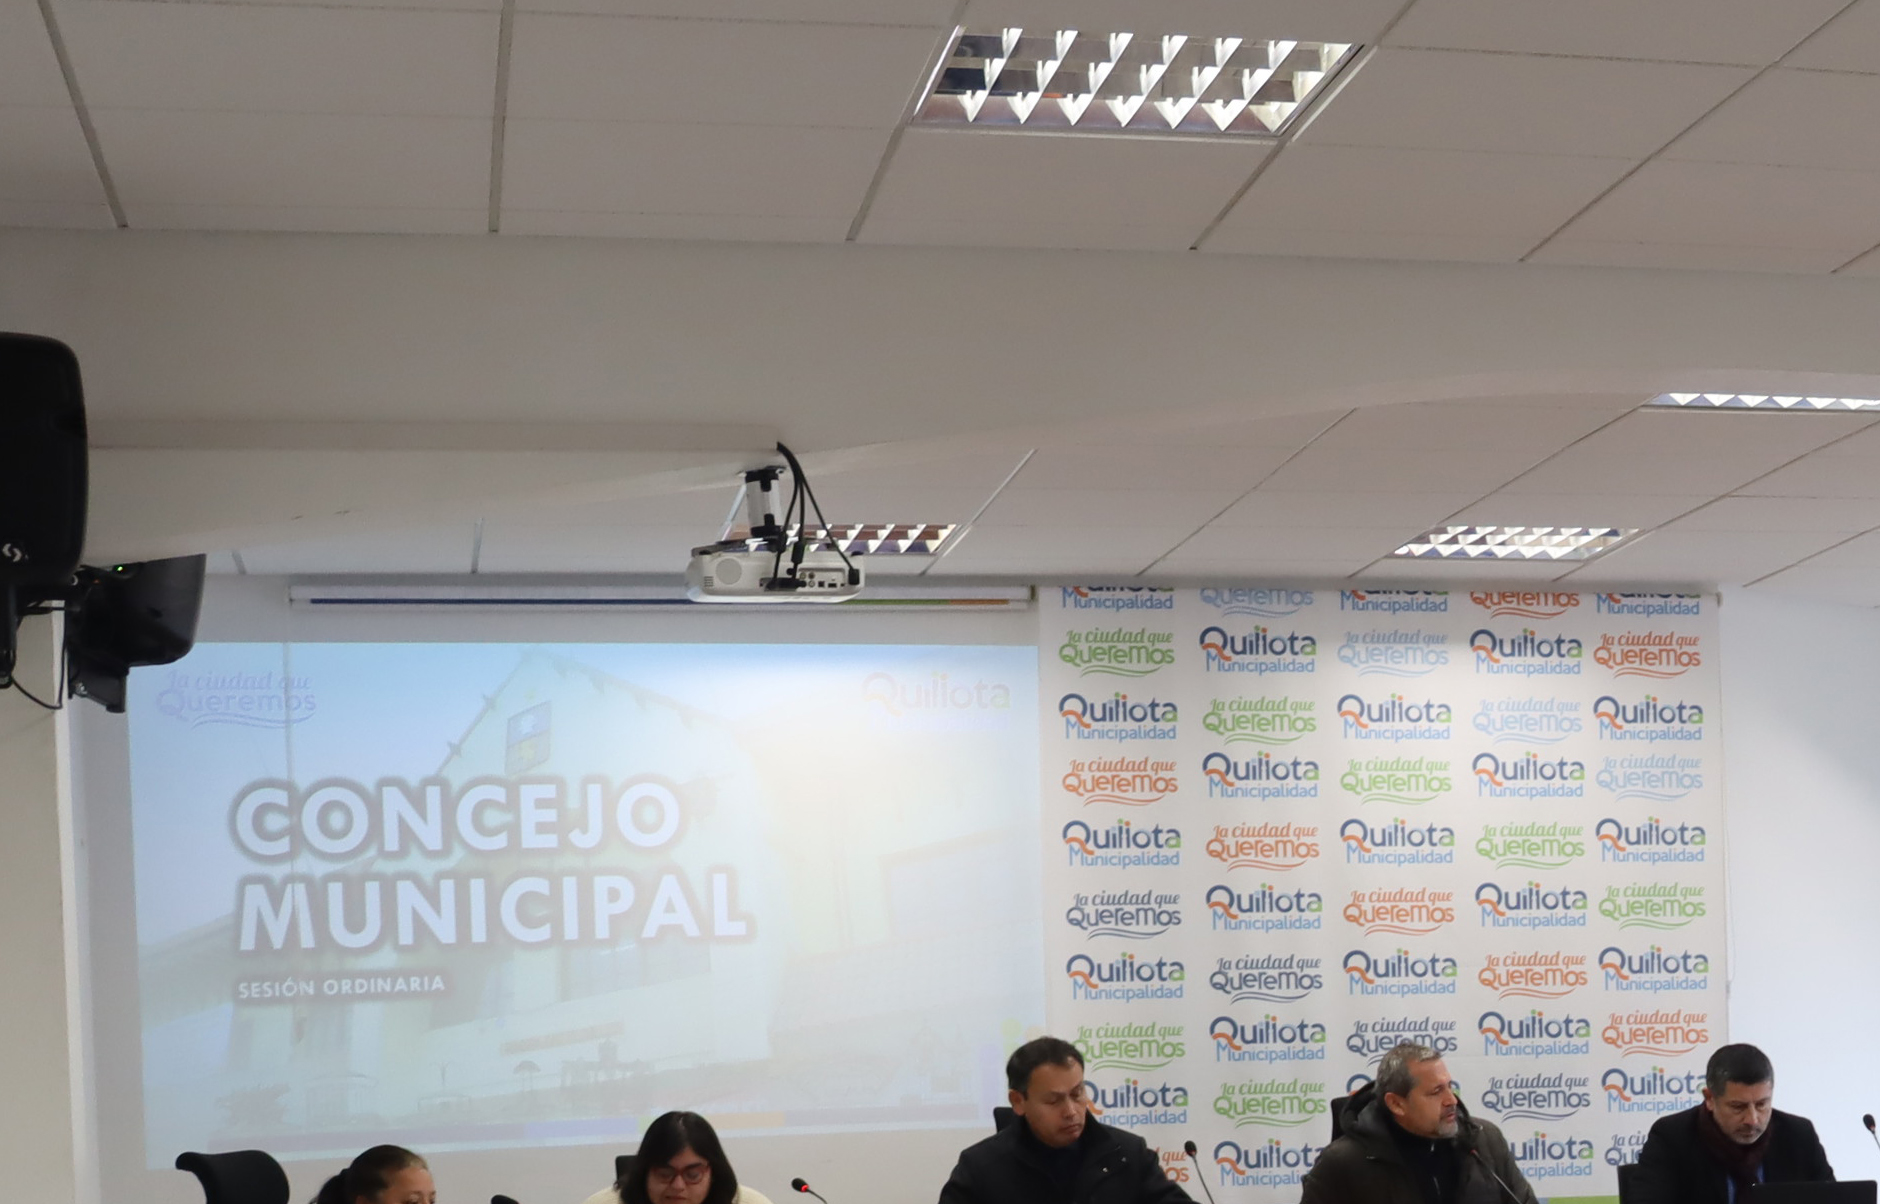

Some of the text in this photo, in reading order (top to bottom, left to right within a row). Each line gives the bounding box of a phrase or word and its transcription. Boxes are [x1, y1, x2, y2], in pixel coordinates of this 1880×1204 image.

[1062, 587, 1173, 611] Municipalidad
[1340, 591, 1448, 614] Municipalidad
[1597, 594, 1700, 617] Municipalidad
[1085, 627, 1145, 643] ciudad
[1148, 630, 1173, 645] que
[1200, 626, 1316, 661] Quillota
[1362, 629, 1420, 644] ciudad
[1423, 631, 1447, 646] que
[1470, 629, 1582, 663] Quillota
[1618, 631, 1673, 646] ciudad
[1676, 634, 1699, 649] que
[1060, 644, 1174, 666] Queremos
[1206, 650, 1315, 675] Municipalidad
[1476, 652, 1580, 676] Municipalidad
[1594, 647, 1700, 668] Queremos
[1059, 693, 1178, 728] Quillota
[1228, 696, 1287, 711] ciudad
[1291, 698, 1315, 714] que
[1338, 693, 1451, 728] Quillota
[1497, 697, 1554, 712] ciudad
[1557, 699, 1581, 714] que
[1594, 695, 1703, 729] Quillota
[1066, 717, 1176, 742] Municipalidad
[1202, 712, 1316, 734] Queremos
[1344, 717, 1449, 742] Municipalidad
[1600, 718, 1702, 742] Municipalidad
[1089, 756, 1149, 772] ciudad
[1152, 759, 1177, 774] que
[1202, 751, 1319, 786] Quillota
[1365, 756, 1423, 771] ciudad
[1426, 758, 1450, 773] que
[1473, 752, 1585, 787] Quillota
[1620, 754, 1675, 769] ciudad
[1678, 756, 1702, 771] que
[1062, 772, 1178, 795] Queremos
[1209, 775, 1317, 800] Municipalidad
[1340, 772, 1451, 794] Queremos
[1479, 775, 1583, 800] Municipalidad
[235, 782, 681, 856] CONCEJO
[1232, 822, 1290, 838] ciudad
[1293, 825, 1318, 840] que
[1500, 821, 1557, 836] ciudad
[1560, 823, 1583, 839] que
[1062, 819, 1181, 854] Quillota
[1340, 818, 1454, 852] Quillota
[1596, 816, 1706, 851] Quillota
[1069, 843, 1179, 868] Municipalidad
[1206, 838, 1319, 861] Queremos
[1346, 841, 1452, 865] Municipalidad
[1476, 837, 1584, 859] Queremos
[1602, 840, 1704, 864] Municipalidad
[1092, 890, 1152, 906] ciudad
[1155, 893, 1180, 909] que
[1206, 883, 1322, 918] Quillota
[1368, 888, 1426, 903] ciudad
[1429, 890, 1453, 906] que
[1475, 881, 1587, 916] Quillota
[1623, 882, 1678, 897] ciudad
[1681, 884, 1705, 899] que
[238, 872, 749, 951] MUNICIPAL
[1066, 907, 1181, 930] Queremos
[1212, 907, 1320, 932] Municipalidad
[1343, 904, 1454, 926] Queremos
[1481, 905, 1586, 929] Municipalidad
[1599, 898, 1706, 920] Queremos
[1067, 953, 1185, 988] Quillota
[1235, 954, 1293, 970] ciudad
[1296, 957, 1321, 973] que
[1343, 949, 1457, 984] Quillota
[1503, 951, 1560, 966] ciudad
[1562, 954, 1586, 969] que
[1599, 945, 1708, 979] Quillota
[238, 975, 445, 999] SESIÓN ORDINARIA
[1073, 977, 1183, 1002] Municipalidad
[1210, 971, 1322, 994] Queremos
[1349, 973, 1455, 997] Municipalidad
[1478, 967, 1587, 989] Queremos
[1605, 969, 1707, 993] Municipalidad
[1371, 1016, 1430, 1033] ciudad
[1431, 1021, 1457, 1035] que
[1478, 1010, 1590, 1044] Quillota
[1626, 1009, 1681, 1024] ciudad
[1684, 1012, 1707, 1027] que
[1096, 1022, 1156, 1038] ciudad
[1158, 1026, 1184, 1040] que
[1210, 1014, 1325, 1050] Quillota
[1602, 1025, 1708, 1047] Queremos
[1216, 1038, 1324, 1063] Municipalidad
[1485, 1033, 1588, 1057] Municipalidad
[1239, 1078, 1298, 1094] ciudad
[1301, 1081, 1325, 1096] que
[1506, 1074, 1562, 1089] ciudad
[1565, 1076, 1589, 1091] que
[1214, 1094, 1326, 1117] Queremos
[1482, 1090, 1590, 1112] Queremos
[1607, 1091, 1701, 1115] Municipalid
[1098, 1109, 1188, 1128] nicipalidad
[1214, 1138, 1325, 1176] Quillot
[1511, 1131, 1594, 1161] uillota
[1162, 1151, 1187, 1166] que
[1522, 1162, 1592, 1180] icipalidad
